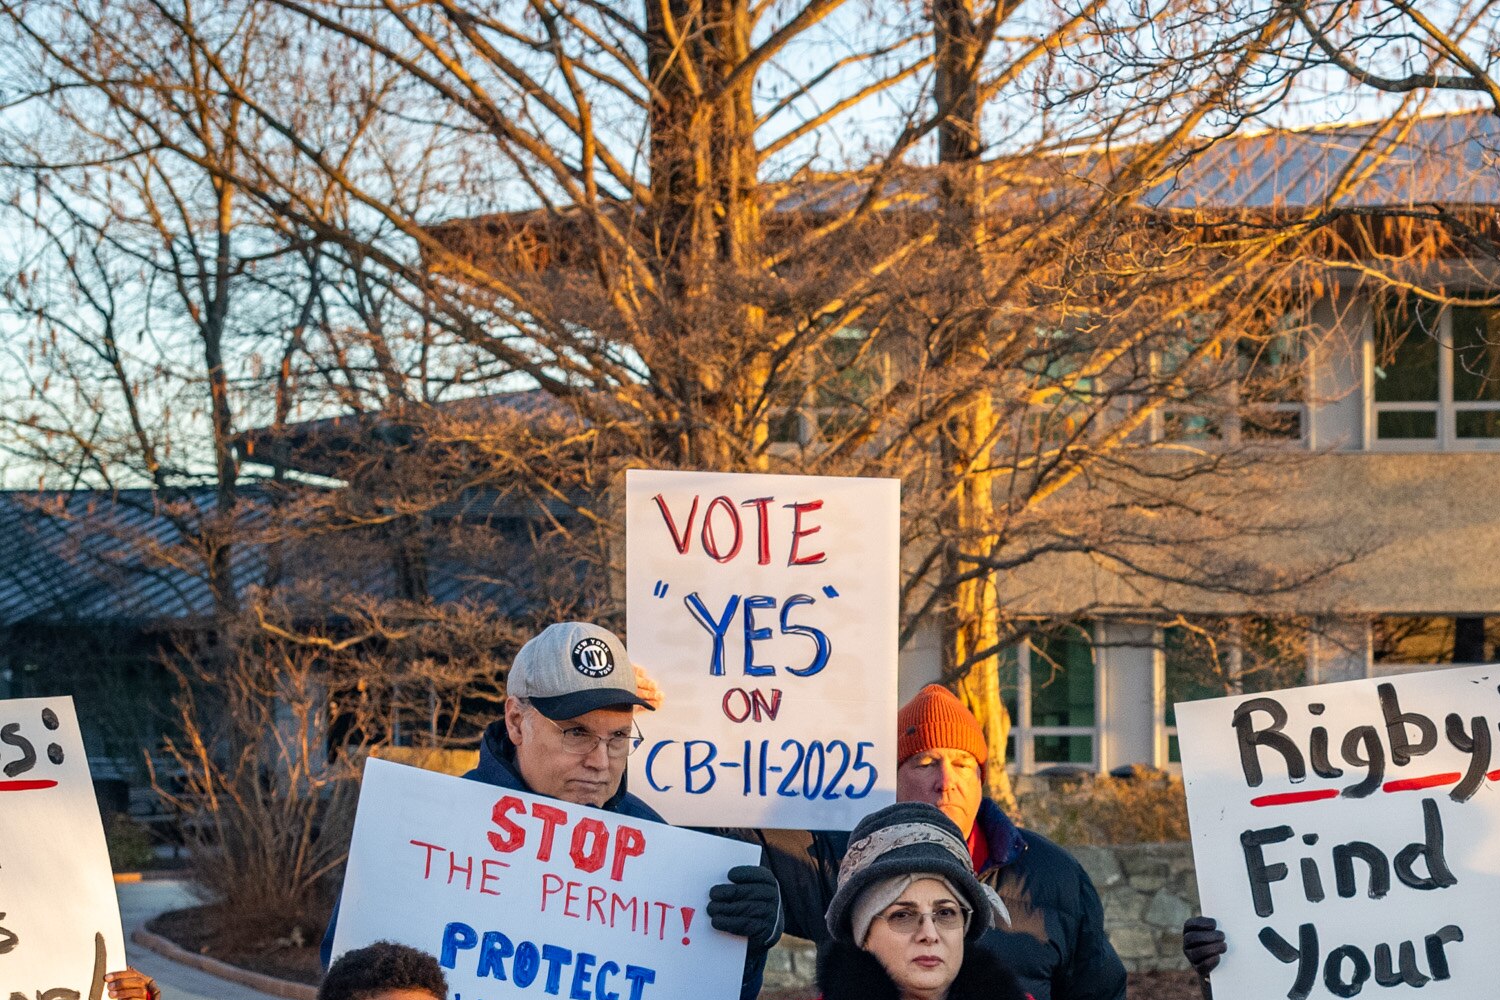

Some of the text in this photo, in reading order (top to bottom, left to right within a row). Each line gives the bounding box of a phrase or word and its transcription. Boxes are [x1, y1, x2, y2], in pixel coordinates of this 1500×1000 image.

[651, 493, 827, 567] VOTE
[574, 639, 609, 655] NEW YORK
[578, 664, 596, 676] NEW
[584, 650, 603, 667] NY
[722, 687, 782, 723] ON
[487, 795, 646, 882] STOP
[1240, 798, 1457, 918] Find
[410, 840, 696, 946] THE PERMIT!
